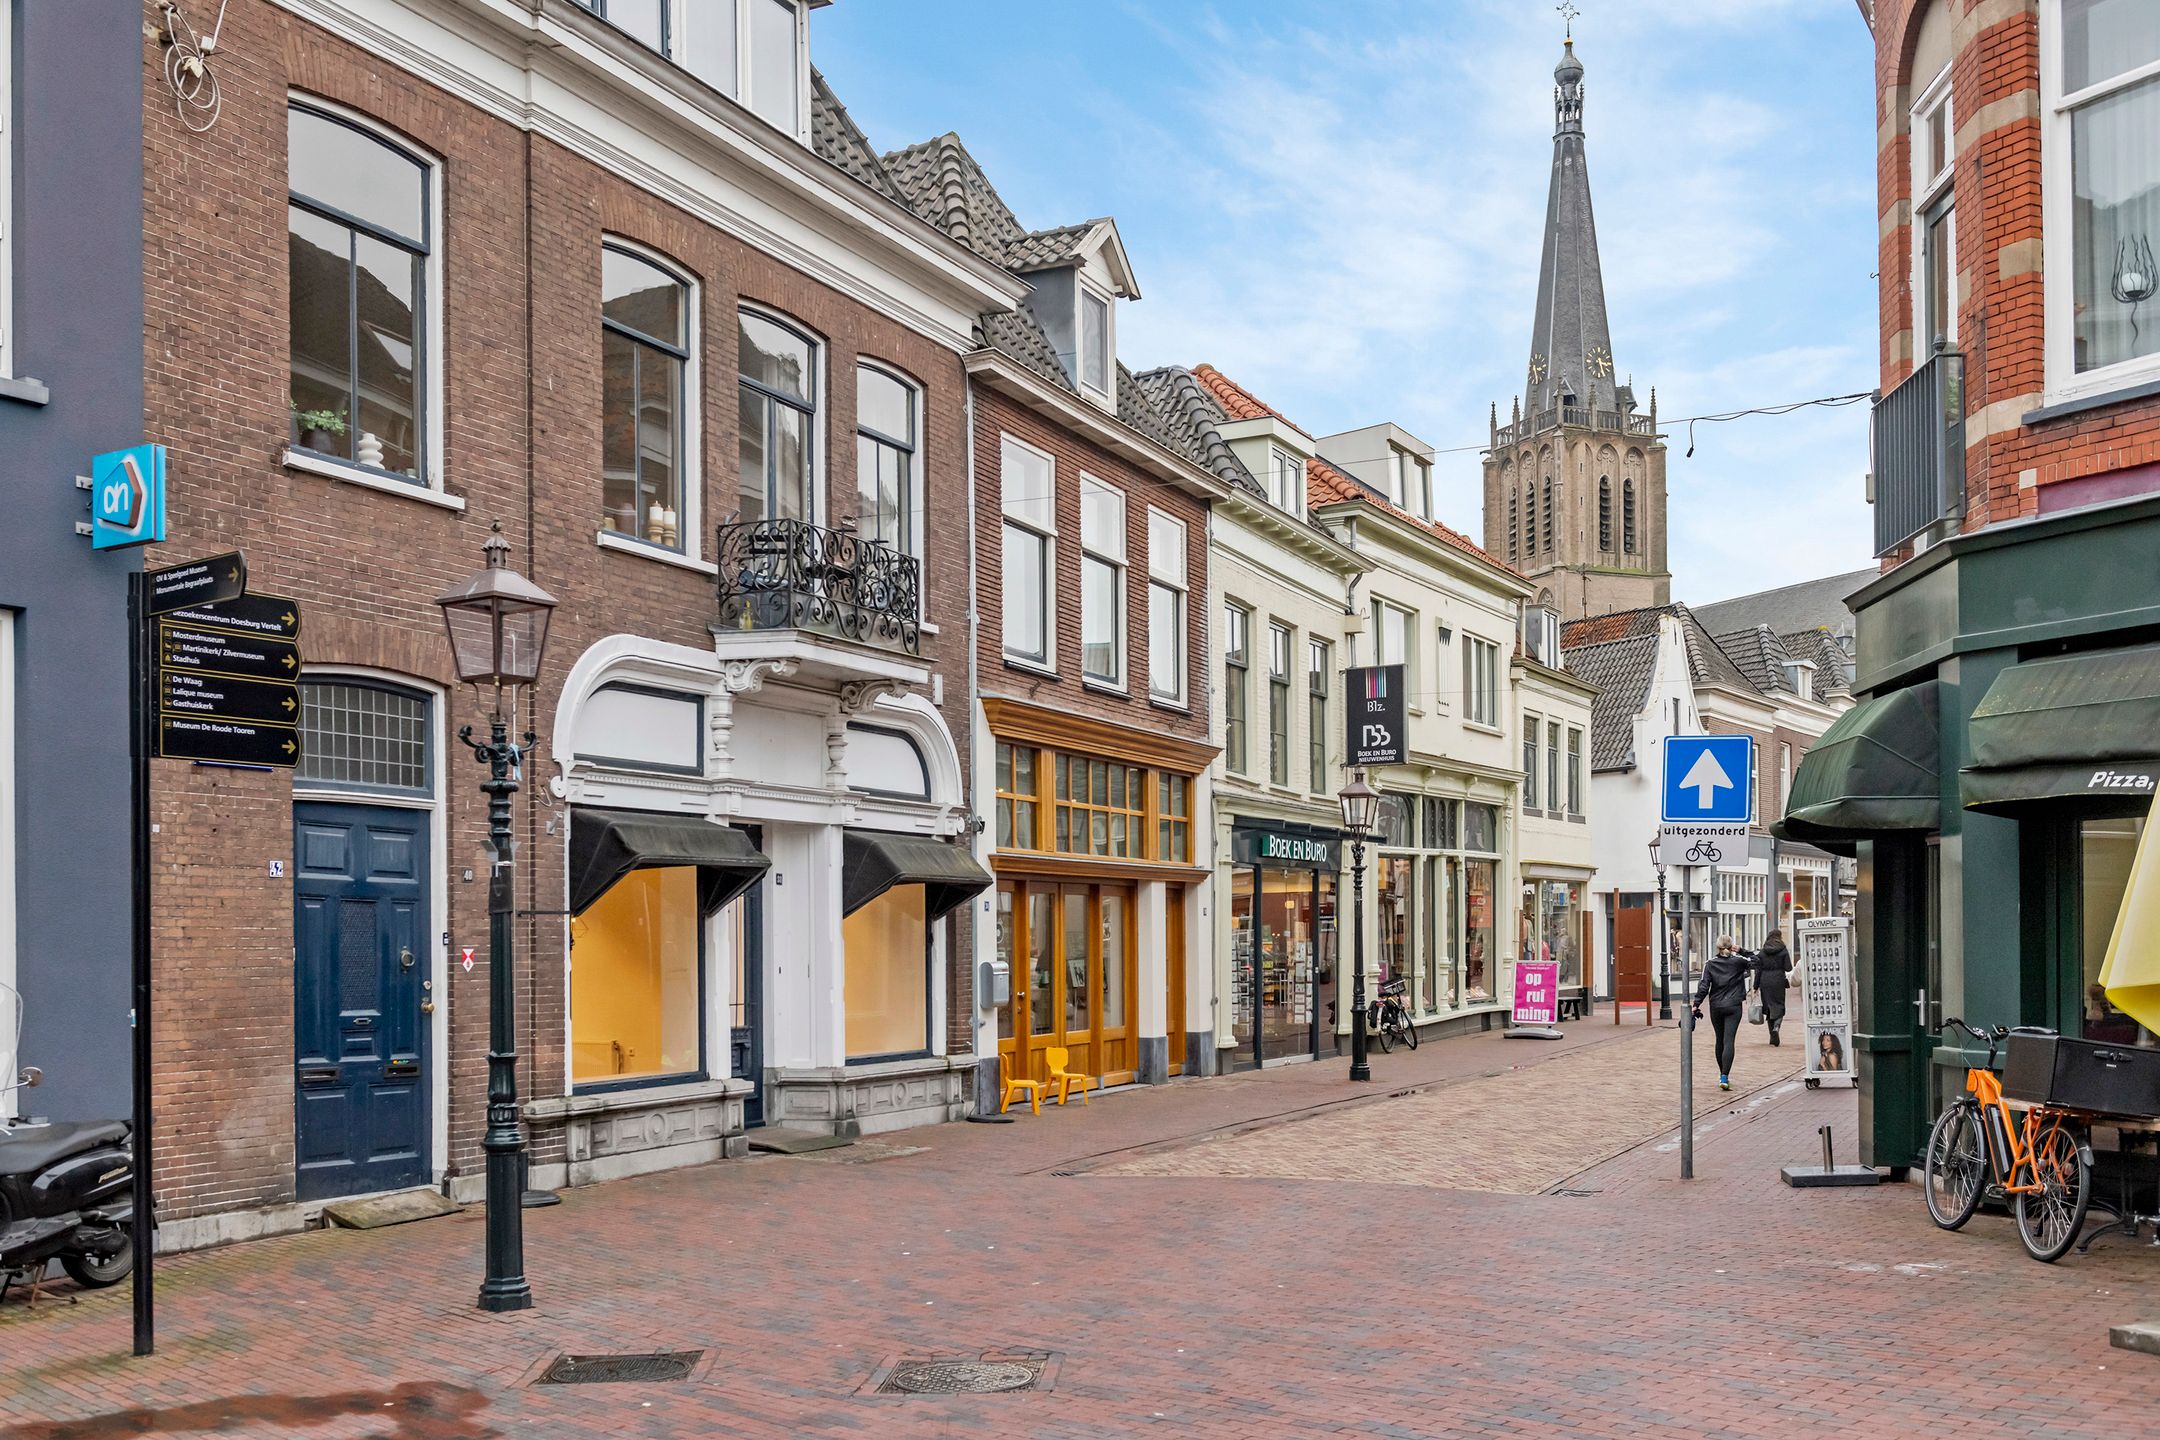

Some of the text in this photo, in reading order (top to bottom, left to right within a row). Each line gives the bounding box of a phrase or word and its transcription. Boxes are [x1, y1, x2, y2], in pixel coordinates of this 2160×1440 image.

[167, 568, 188, 581] Speelgoed
[189, 565, 208, 575] Museum
[156, 576, 214, 594] Monumentale Begraafplaats
[231, 617, 260, 629] Doesburg
[261, 621, 282, 631] Vertelt
[173, 631, 226, 644] Mosterdmuseum
[182, 644, 265, 660] Martinikerk/ Zilvermuseum
[173, 655, 200, 664] Stadhuis
[183, 677, 203, 687] Waag
[173, 688, 224, 700] Lalique museum
[173, 700, 214, 710] Gasthuiskerk
[173, 721, 255, 735] Museum De Roode Tooren
[1358, 755, 1395, 763] NIEUWENHUIS
[2088, 771, 2155, 791] Pizza,
[1664, 826, 1745, 838] uitgezonderd
[1270, 835, 1327, 862] BOEK EN BURO
[464, 870, 473, 881] 40
[1808, 920, 1837, 928] OLYMPIC
[1525, 973, 1542, 986] op
[1526, 989, 1545, 1003] rui
[1517, 1006, 1550, 1022] ming
